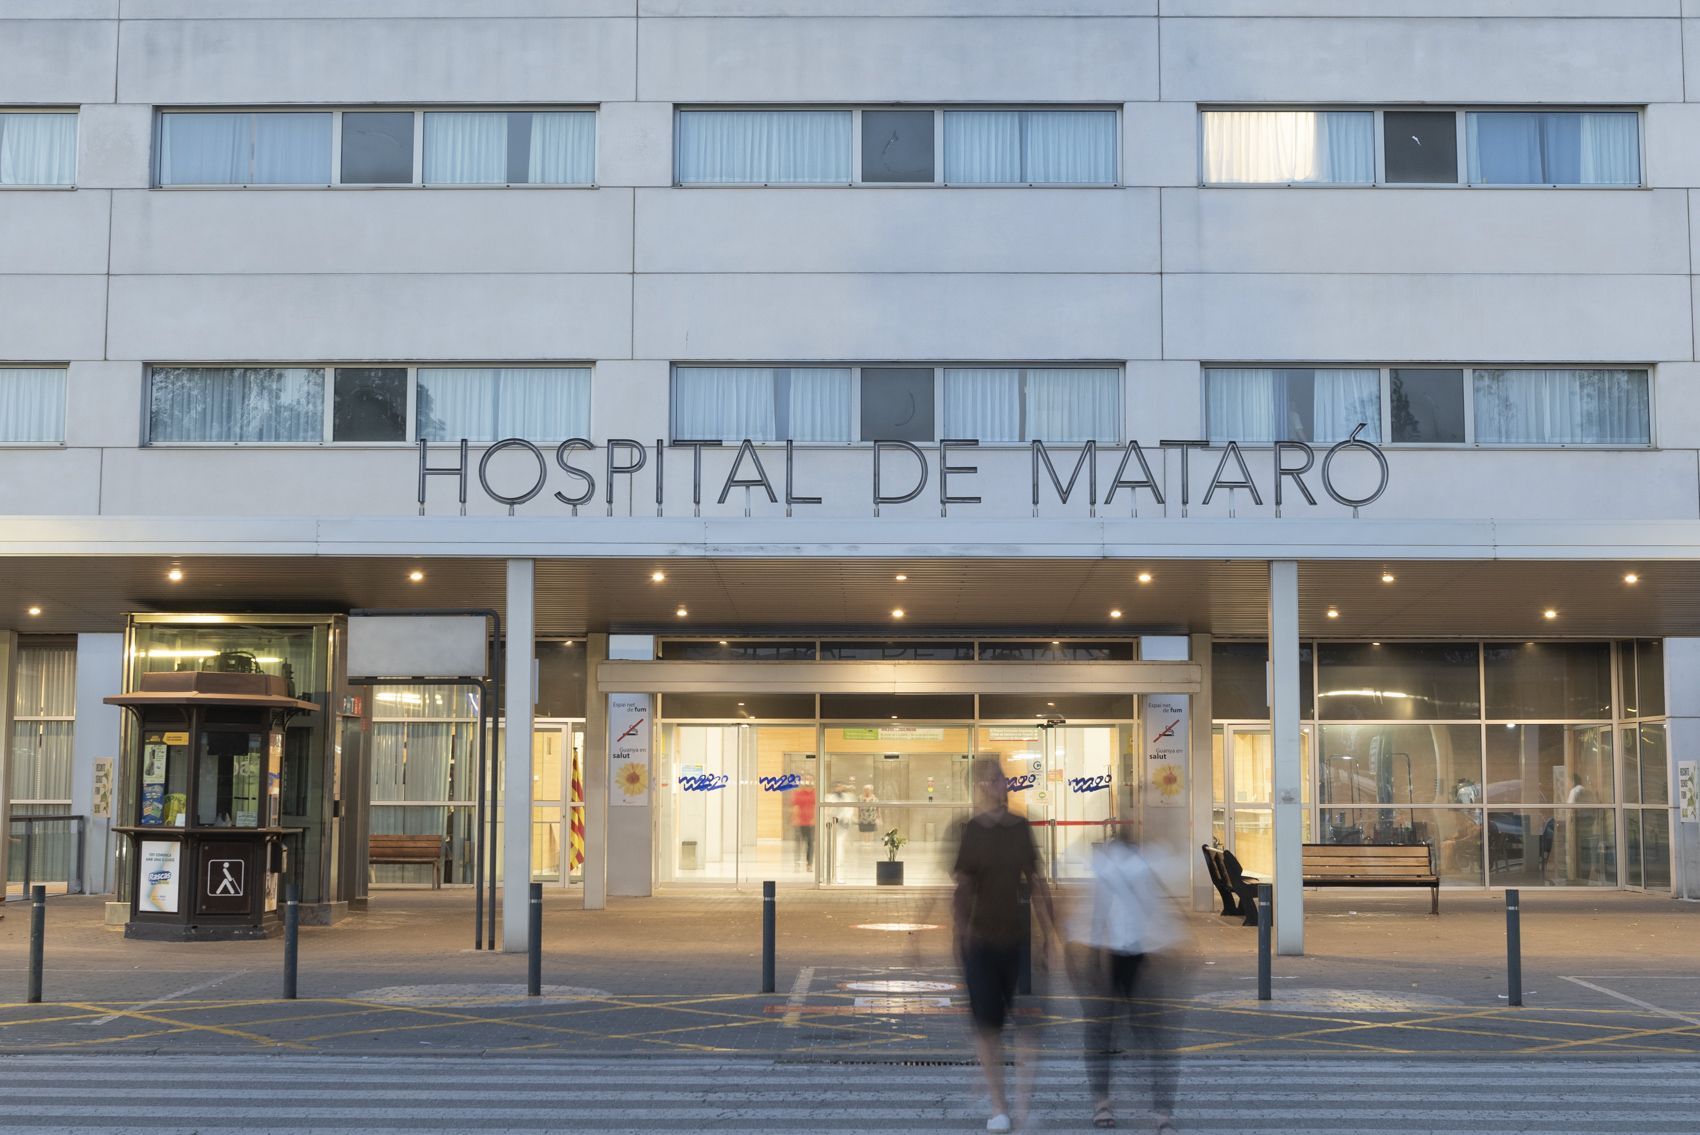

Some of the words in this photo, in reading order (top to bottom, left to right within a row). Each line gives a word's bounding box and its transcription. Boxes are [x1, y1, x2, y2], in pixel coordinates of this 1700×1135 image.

[418, 438, 822, 505] HOSPITAL
[873, 439, 982, 505] DE
[1032, 423, 1389, 507] MATARÓ
[1148, 702, 1162, 710] Espai
